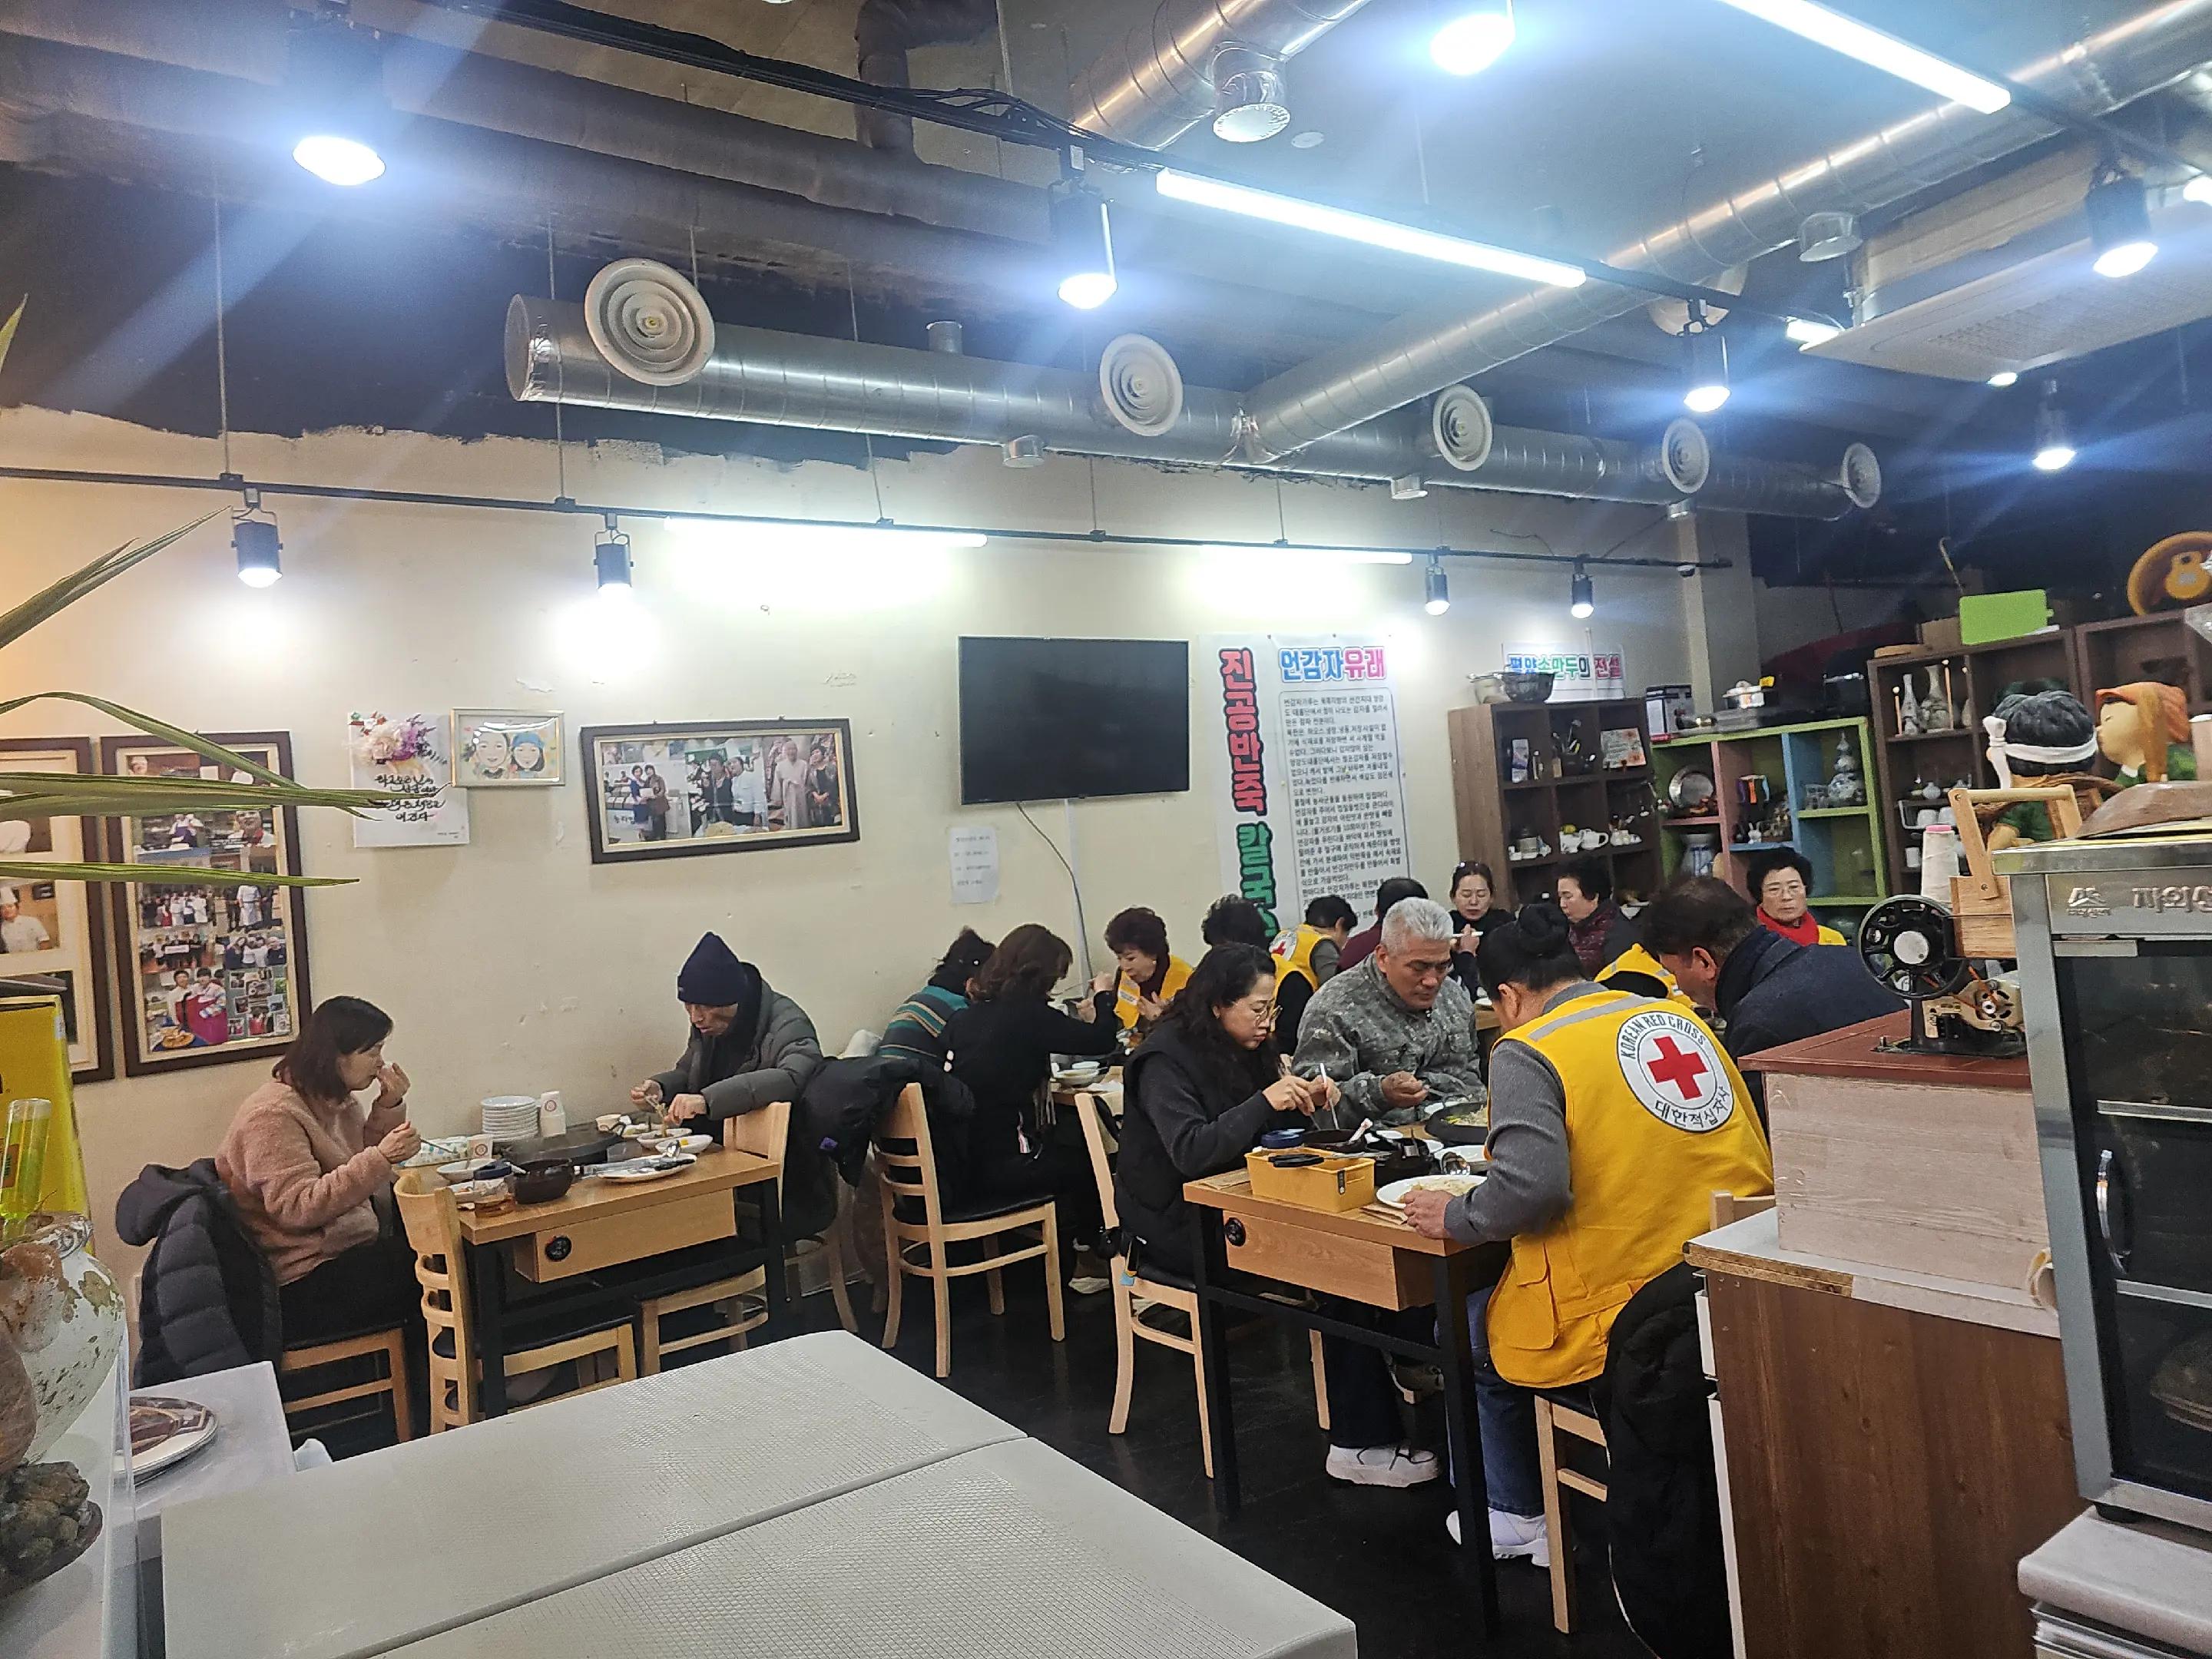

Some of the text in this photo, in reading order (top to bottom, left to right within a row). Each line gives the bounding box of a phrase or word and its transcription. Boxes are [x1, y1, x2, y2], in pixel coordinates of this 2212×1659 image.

[1621, 1014, 1706, 1060] KOREAN RED CROSS
[1654, 1085, 1730, 1128] 대한적십자사
